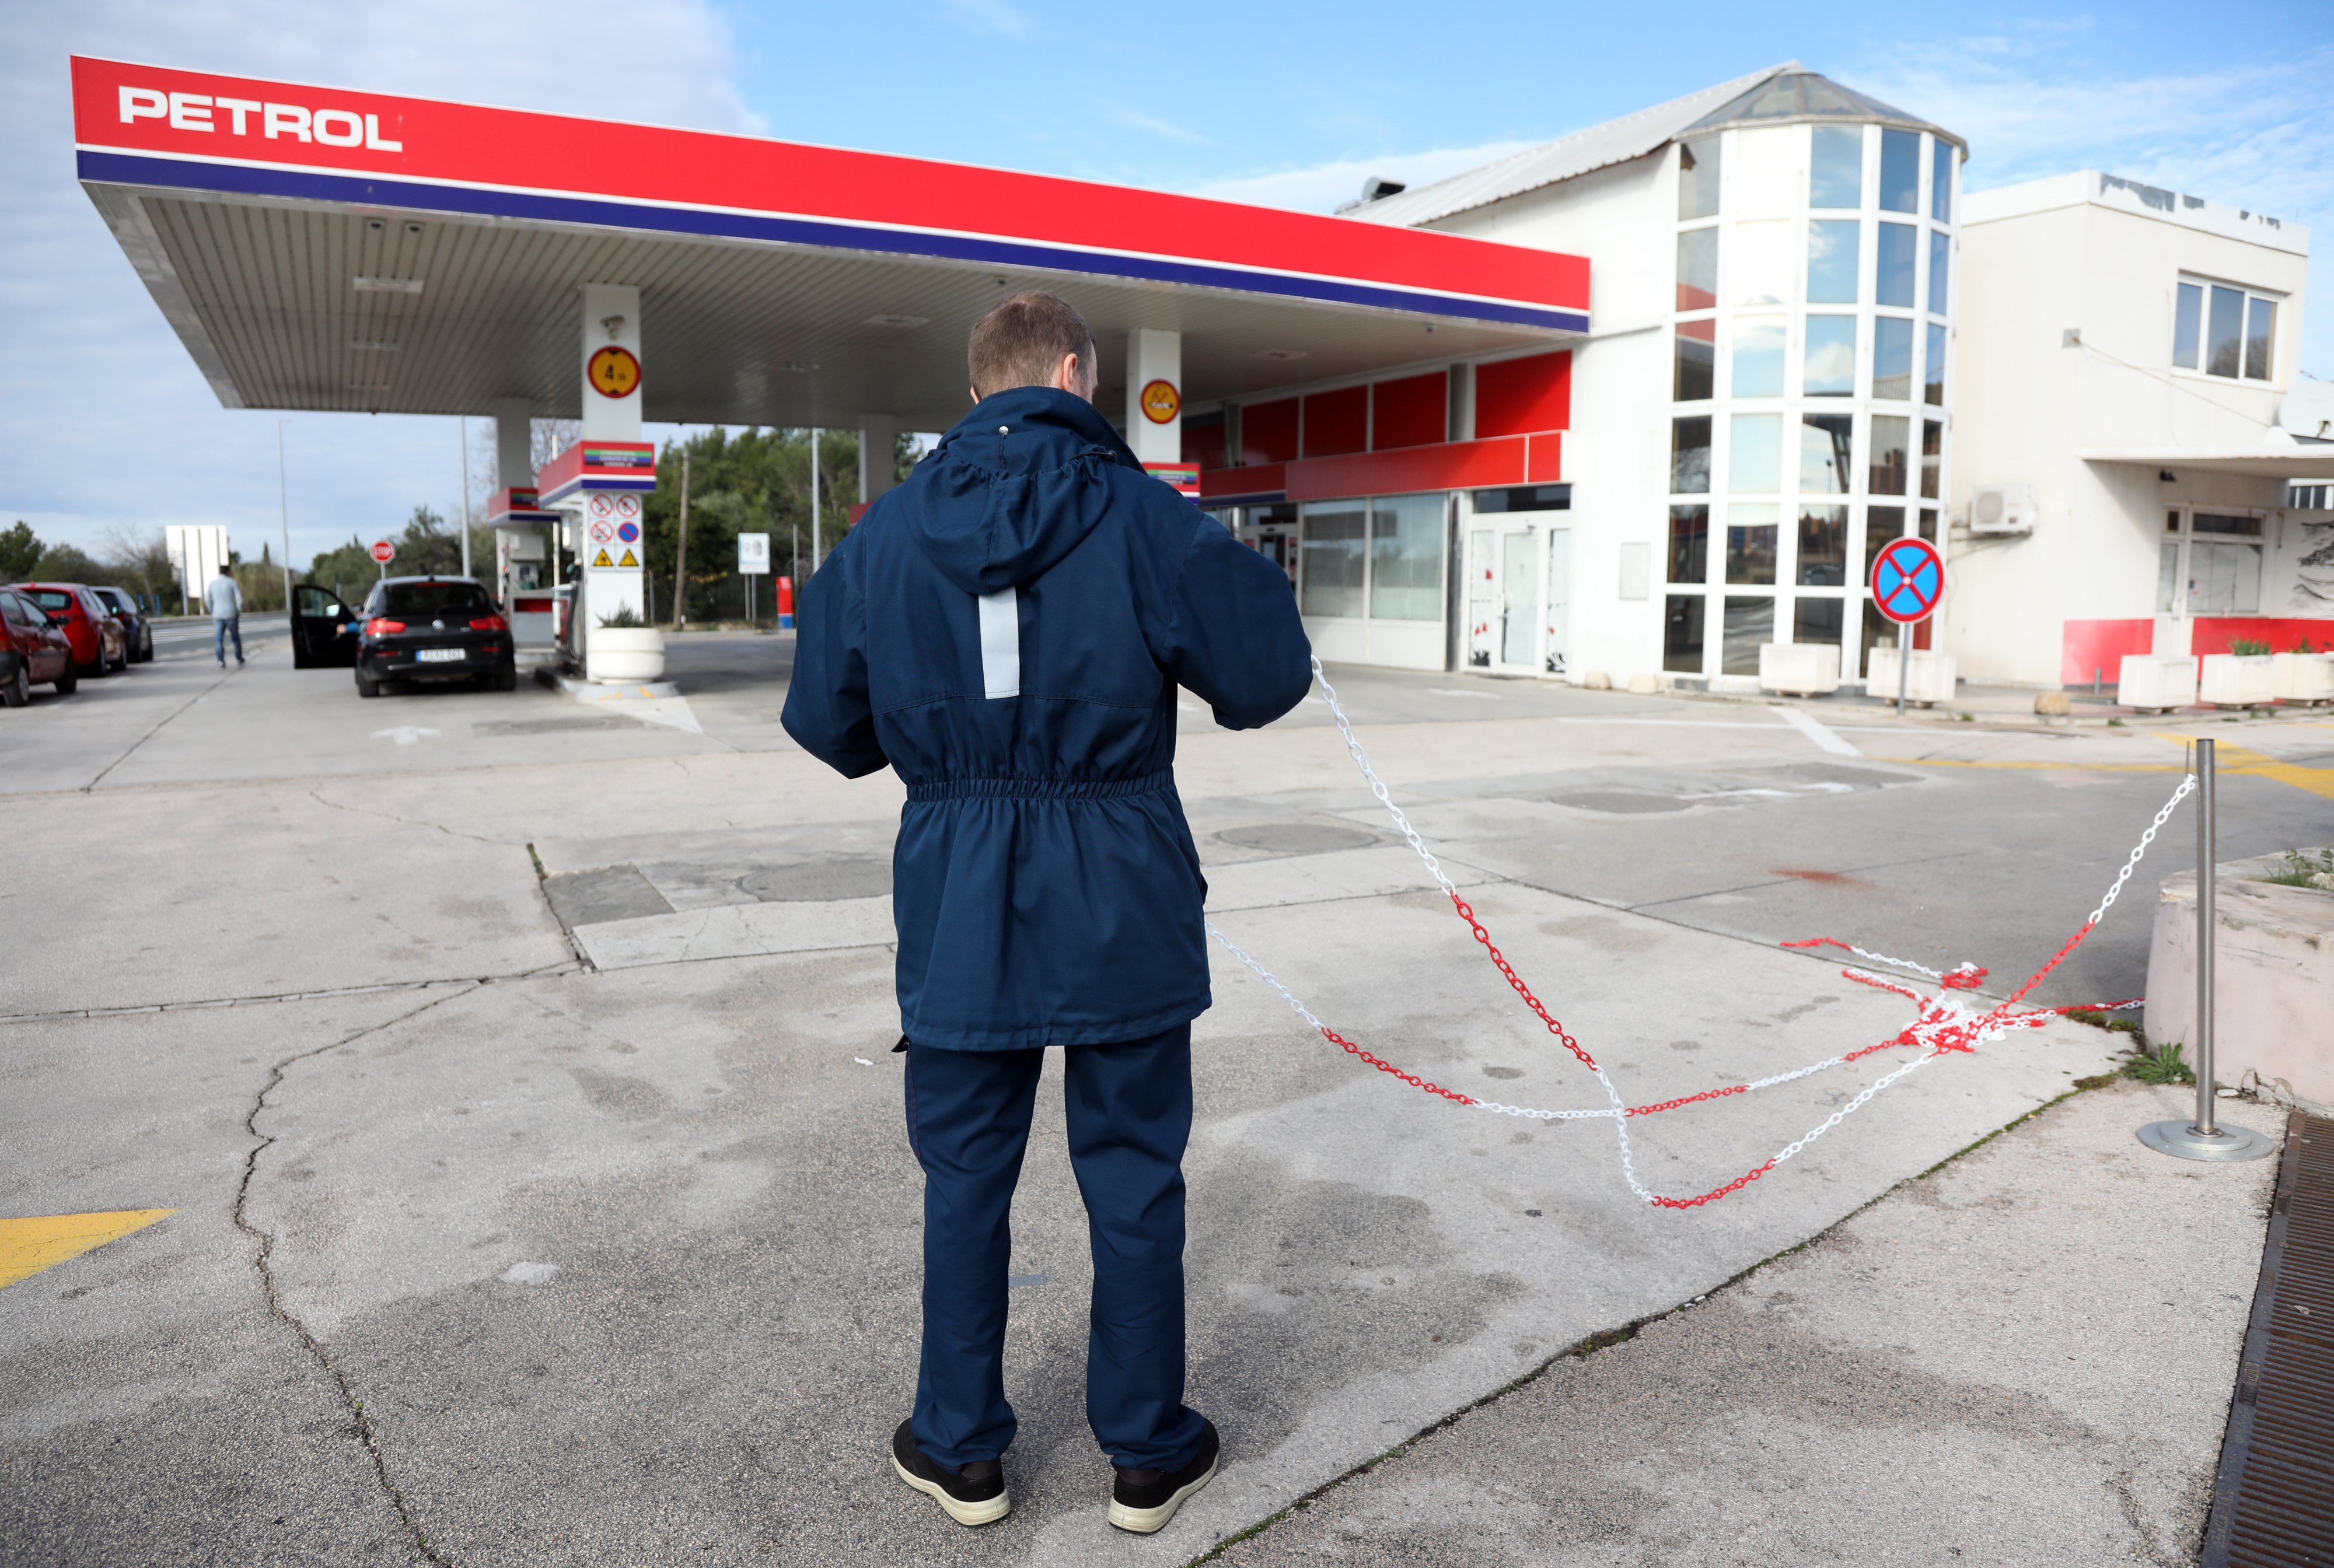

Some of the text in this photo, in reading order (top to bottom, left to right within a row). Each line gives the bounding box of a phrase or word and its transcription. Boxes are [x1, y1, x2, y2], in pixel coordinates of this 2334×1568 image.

[118, 85, 403, 153] PETROL
[604, 363, 627, 381] 4 m
[373, 545, 392, 556] STOP
